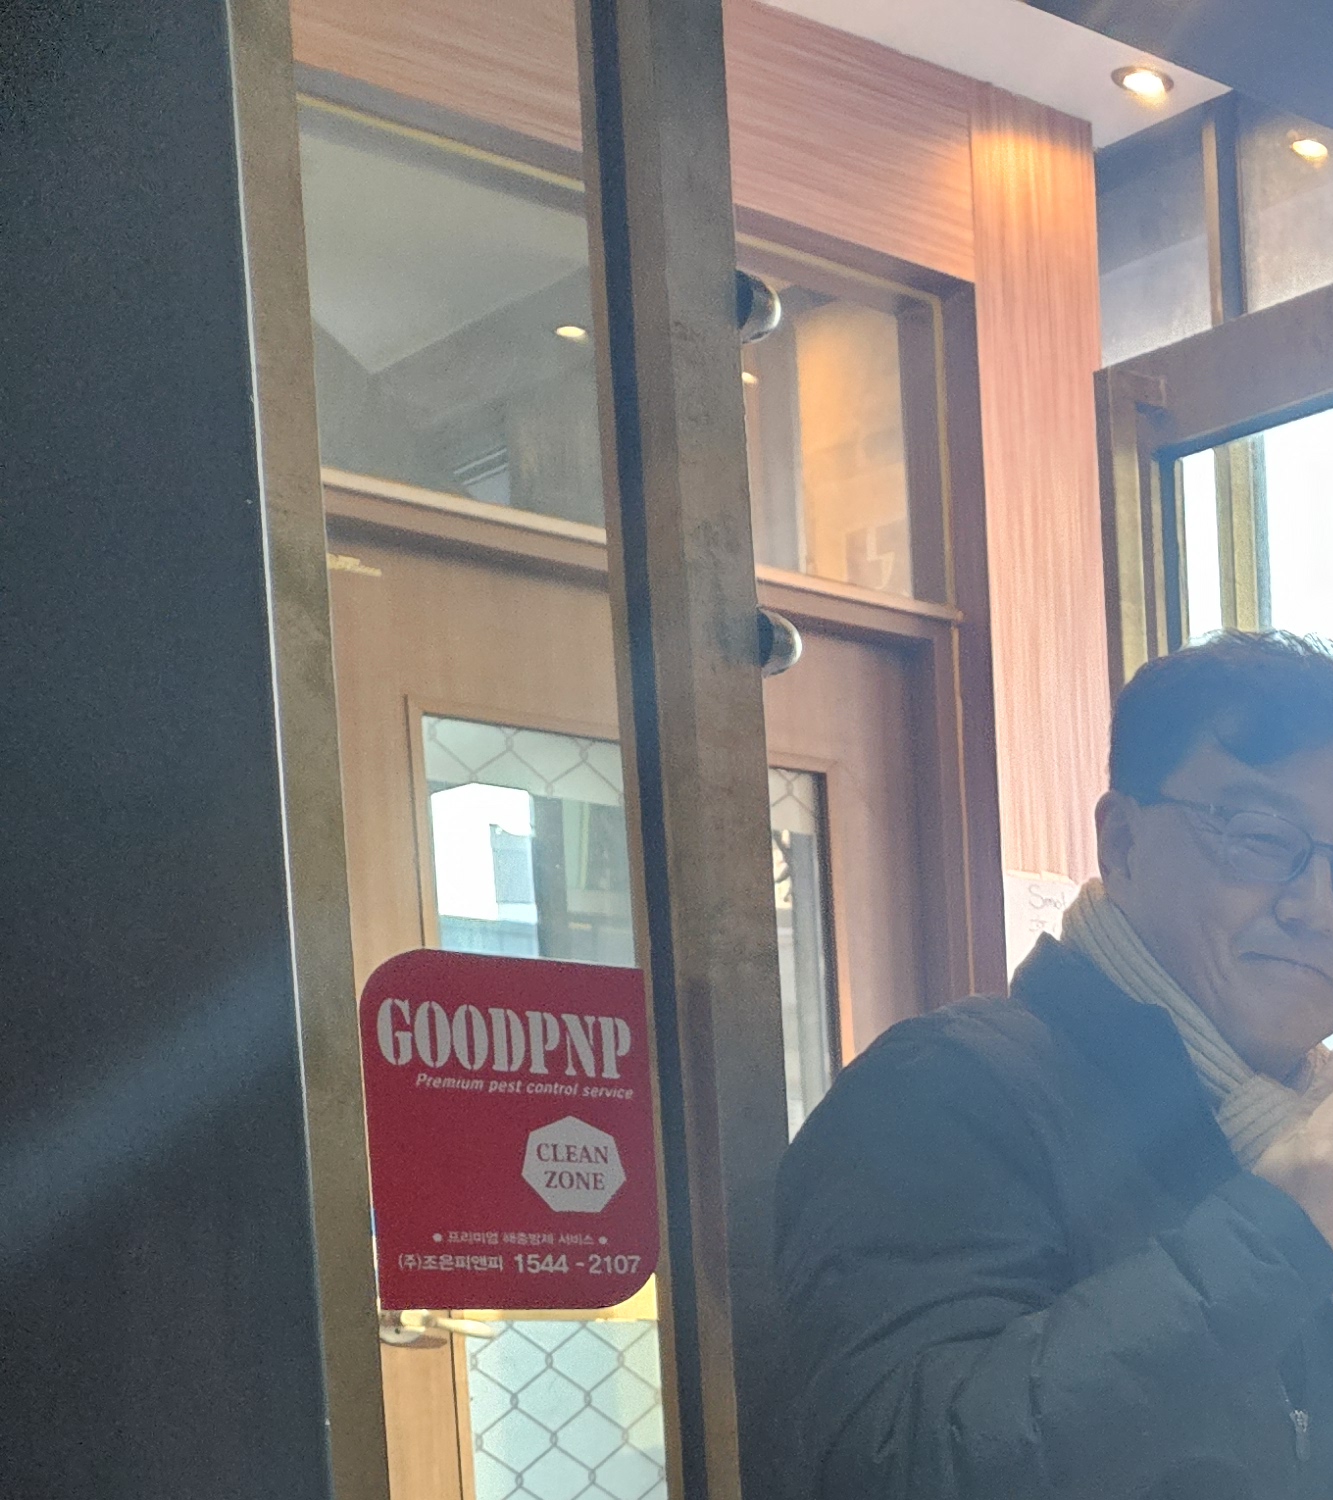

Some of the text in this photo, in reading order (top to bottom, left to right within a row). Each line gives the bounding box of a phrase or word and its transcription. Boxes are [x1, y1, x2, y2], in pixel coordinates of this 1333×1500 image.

[377, 998, 631, 1079] GOODPNP
[415, 1073, 634, 1099] Premium pest control service
[536, 1143, 609, 1164] CLEAN
[544, 1171, 605, 1190] ZONE
[447, 1231, 499, 1244] 프리미엄
[558, 1233, 594, 1245] 서비스
